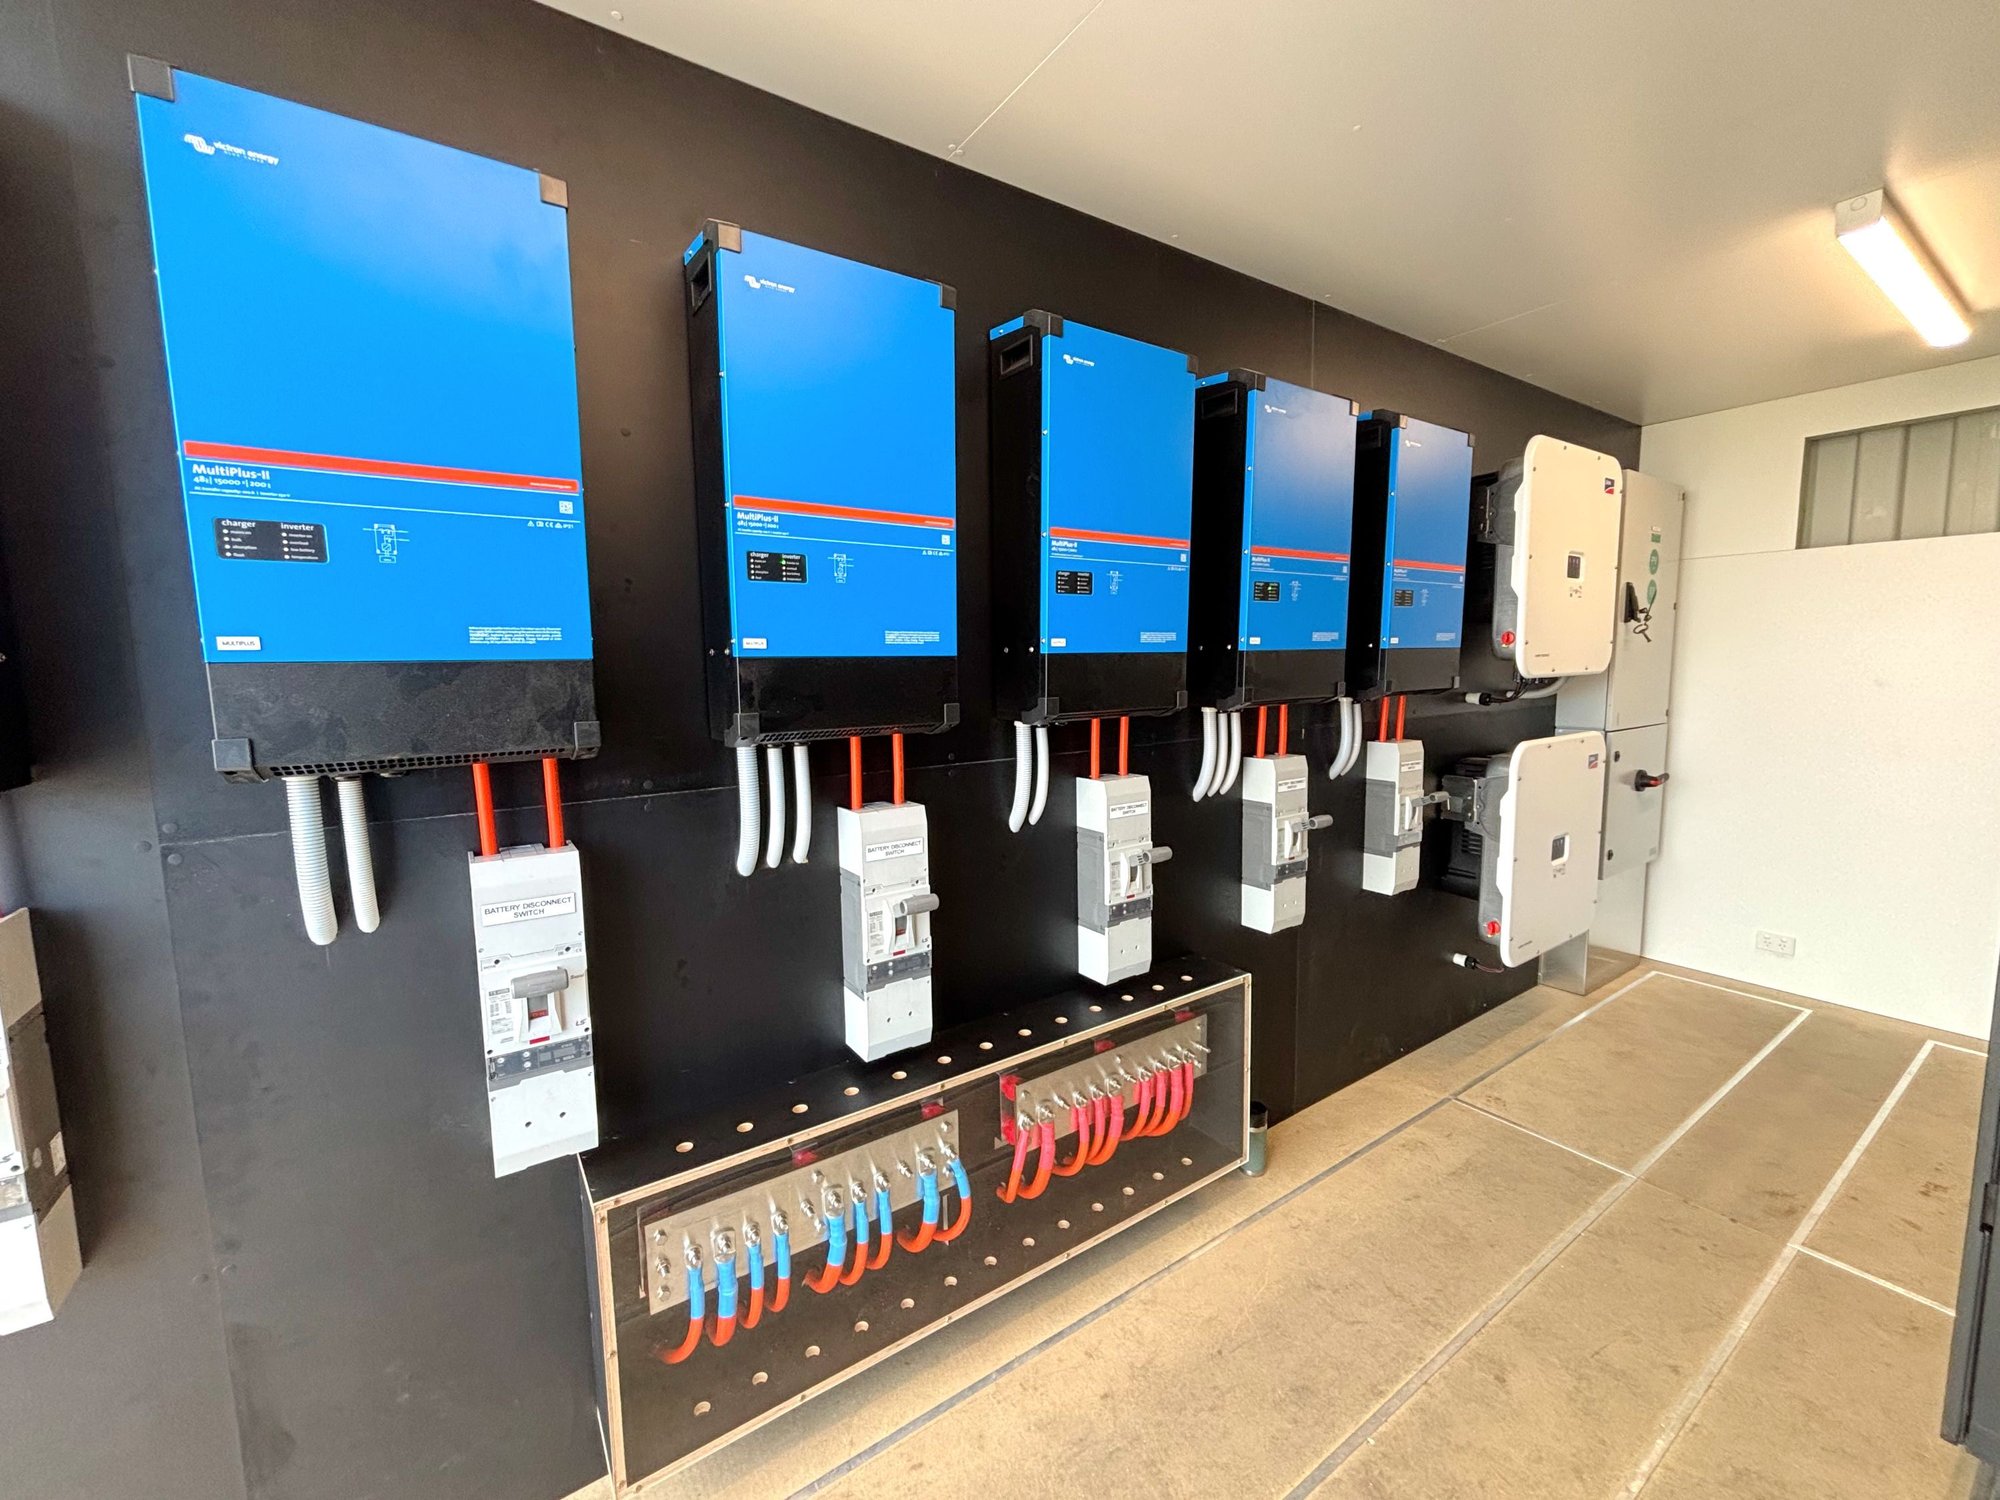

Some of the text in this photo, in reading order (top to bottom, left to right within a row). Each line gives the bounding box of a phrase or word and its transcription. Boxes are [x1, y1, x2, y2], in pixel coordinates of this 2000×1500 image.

[192, 464, 270, 480] MultiPlus-II
[221, 519, 256, 529] charger
[281, 522, 314, 531] inverter
[890, 840, 921, 850] DISCONNECT
[484, 896, 572, 915] BATTERY DISCONNECT
[513, 909, 545, 919] SWITCH
